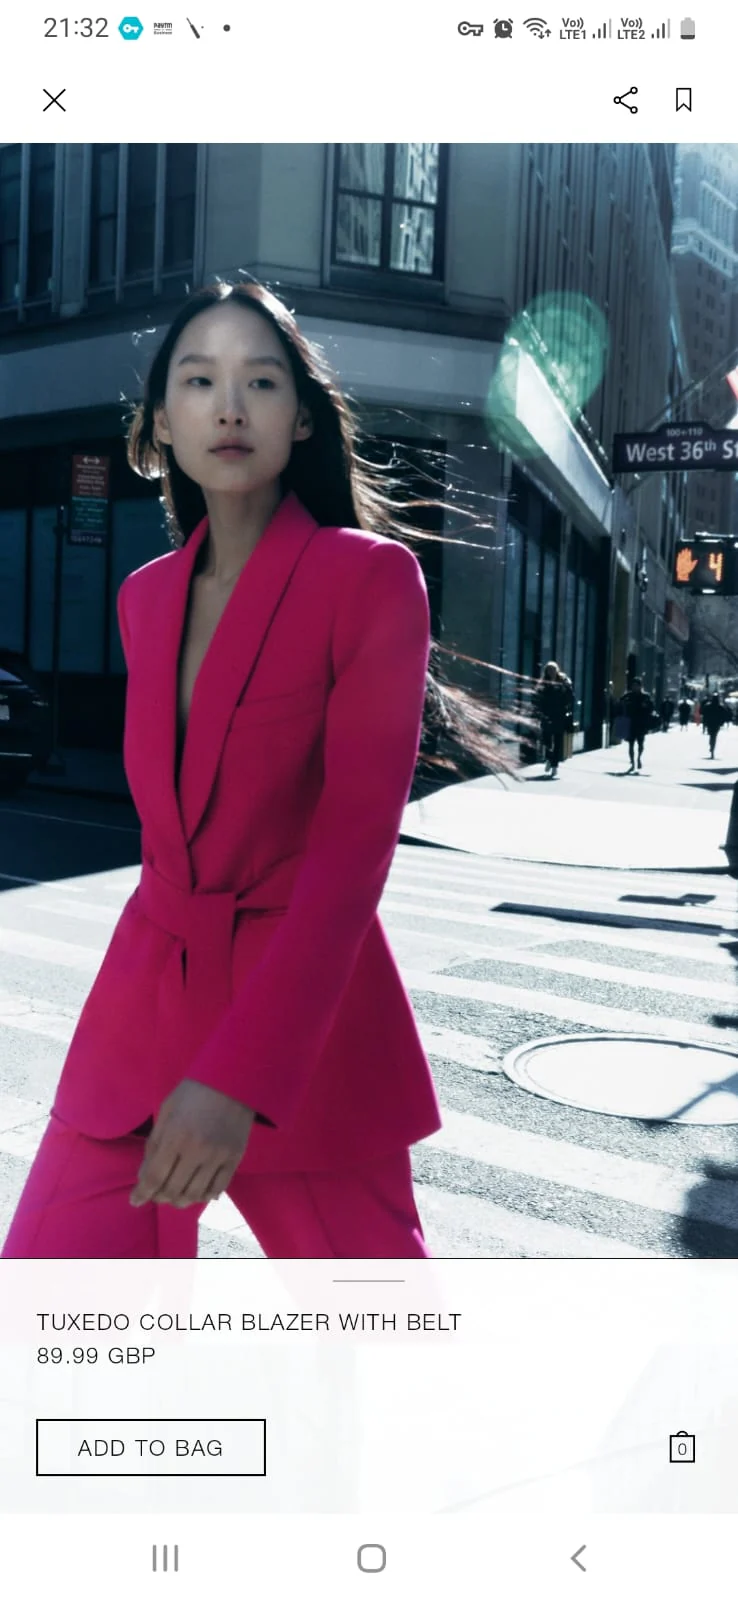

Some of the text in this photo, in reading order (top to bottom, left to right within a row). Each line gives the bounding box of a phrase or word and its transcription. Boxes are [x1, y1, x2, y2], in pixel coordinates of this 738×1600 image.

[44, 17, 109, 38] 21:32
[559, 29, 587, 40] LTE1
[617, 29, 646, 40] LTE2
[626, 443, 675, 462] West
[680, 439, 717, 460] 36th
[708, 553, 723, 581] 4
[36, 1313, 462, 1331] TUXEDO COLLAR BLAZER WITH BELT
[37, 1347, 156, 1364] 89.99 GBP
[77, 1439, 223, 1457] ADD TO BAG
[677, 1442, 688, 1456] 0
